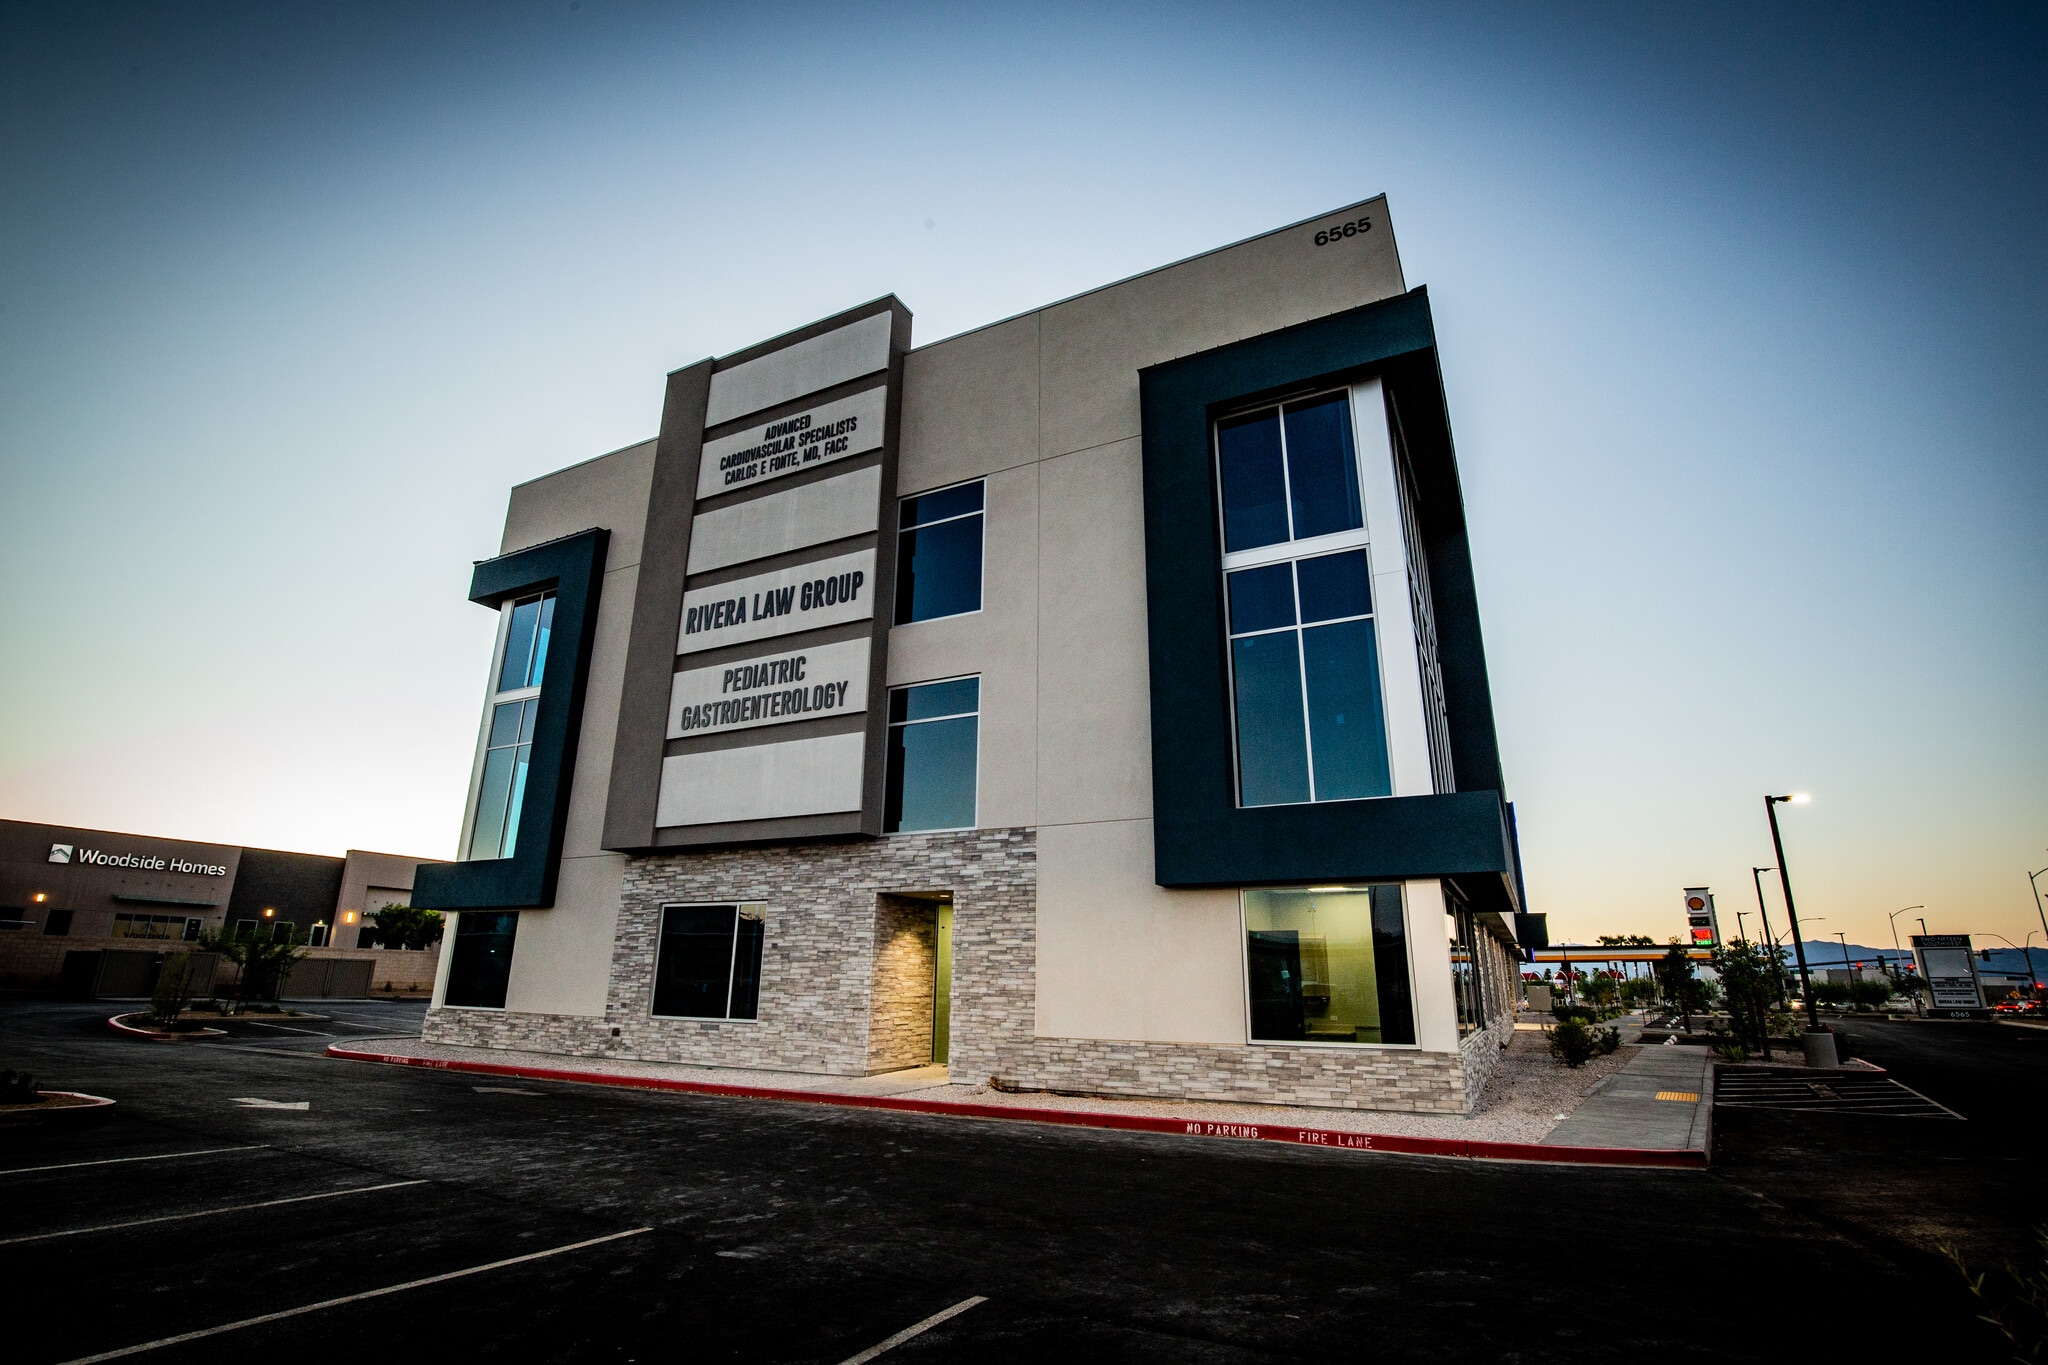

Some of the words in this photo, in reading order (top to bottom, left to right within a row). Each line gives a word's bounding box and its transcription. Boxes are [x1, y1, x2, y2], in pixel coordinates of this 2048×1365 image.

[1314, 216, 1372, 246] 6565
[720, 436, 795, 471] CARDIOVASCULAR
[798, 416, 857, 447] SPECIALISTS
[764, 414, 811, 441] ADVANCED
[725, 463, 758, 485] CARLOS
[760, 460, 767, 475] E
[769, 451, 800, 473] FONTE,
[803, 445, 821, 463] MD,
[824, 436, 848, 456] FACC
[685, 596, 747, 635] RIVERA
[752, 585, 796, 621] LAW
[800, 571, 864, 611] GROUP
[722, 656, 807, 693] PEDIATRIC
[681, 680, 848, 731] GASTROENTEROLOGY
[79, 848, 166, 871] Woodside
[169, 858, 227, 876] Homes
[1186, 1122, 1201, 1135] NO
[1207, 1123, 1259, 1139] PARKING
[1299, 1131, 1328, 1145] FIRE
[1338, 1134, 1372, 1149] LANE
